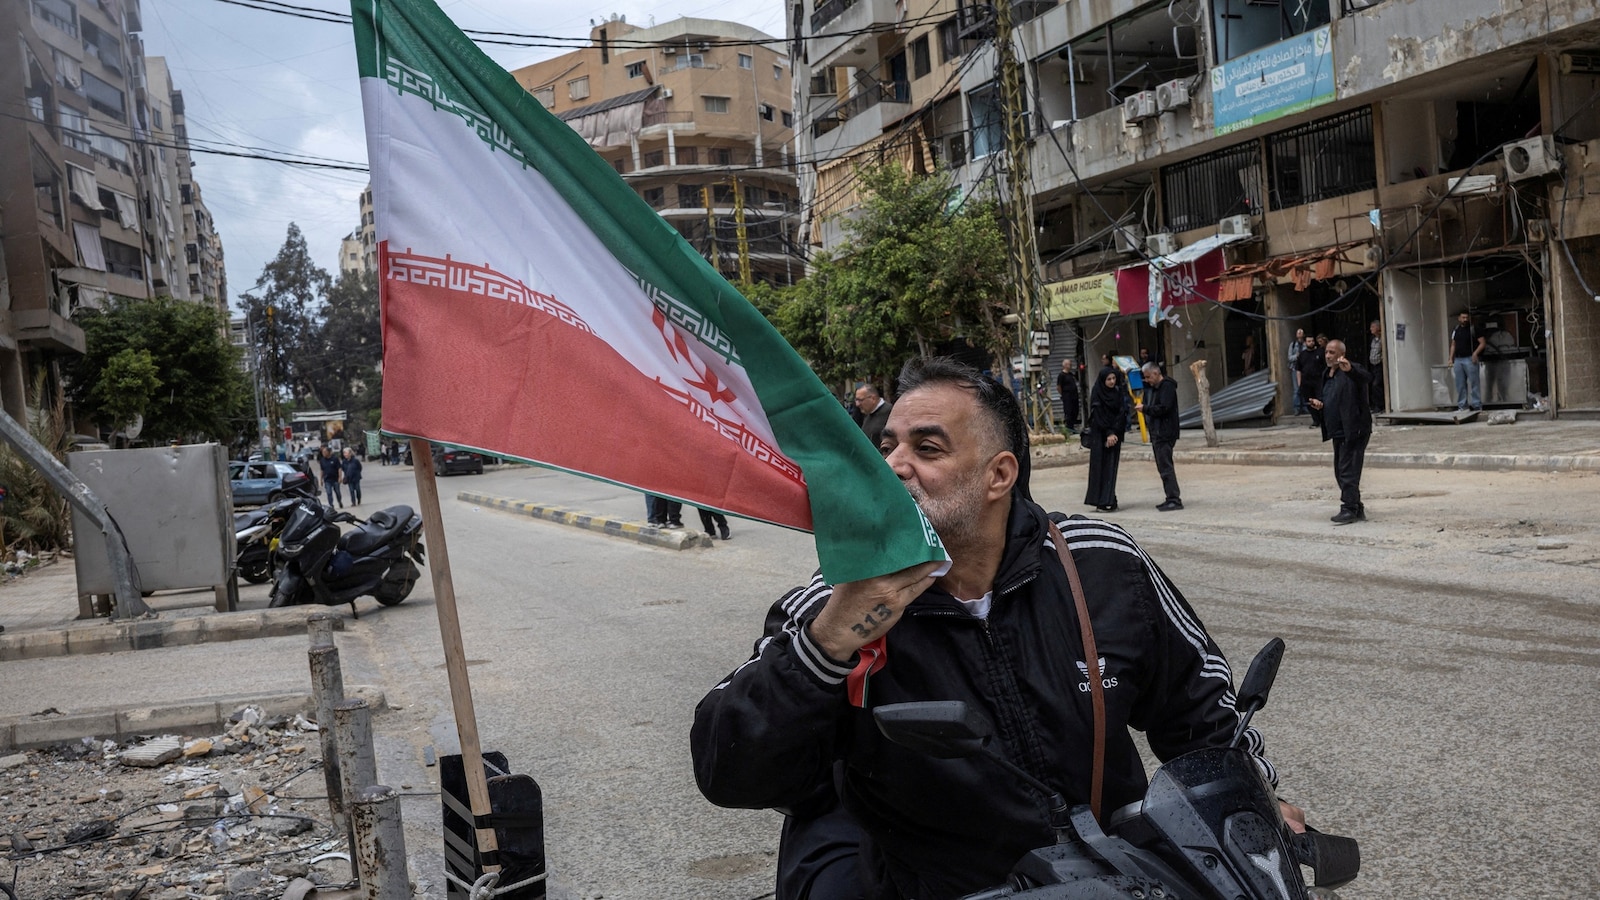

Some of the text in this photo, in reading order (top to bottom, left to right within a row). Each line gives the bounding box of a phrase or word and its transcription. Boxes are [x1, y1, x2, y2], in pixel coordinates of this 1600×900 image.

[1272, 47, 1295, 67] الصادق
[1295, 45, 1312, 60] مركز
[1252, 54, 1272, 73] للعلاج
[1055, 278, 1102, 296] AMMAR HOUSE
[851, 603, 892, 639] 313
